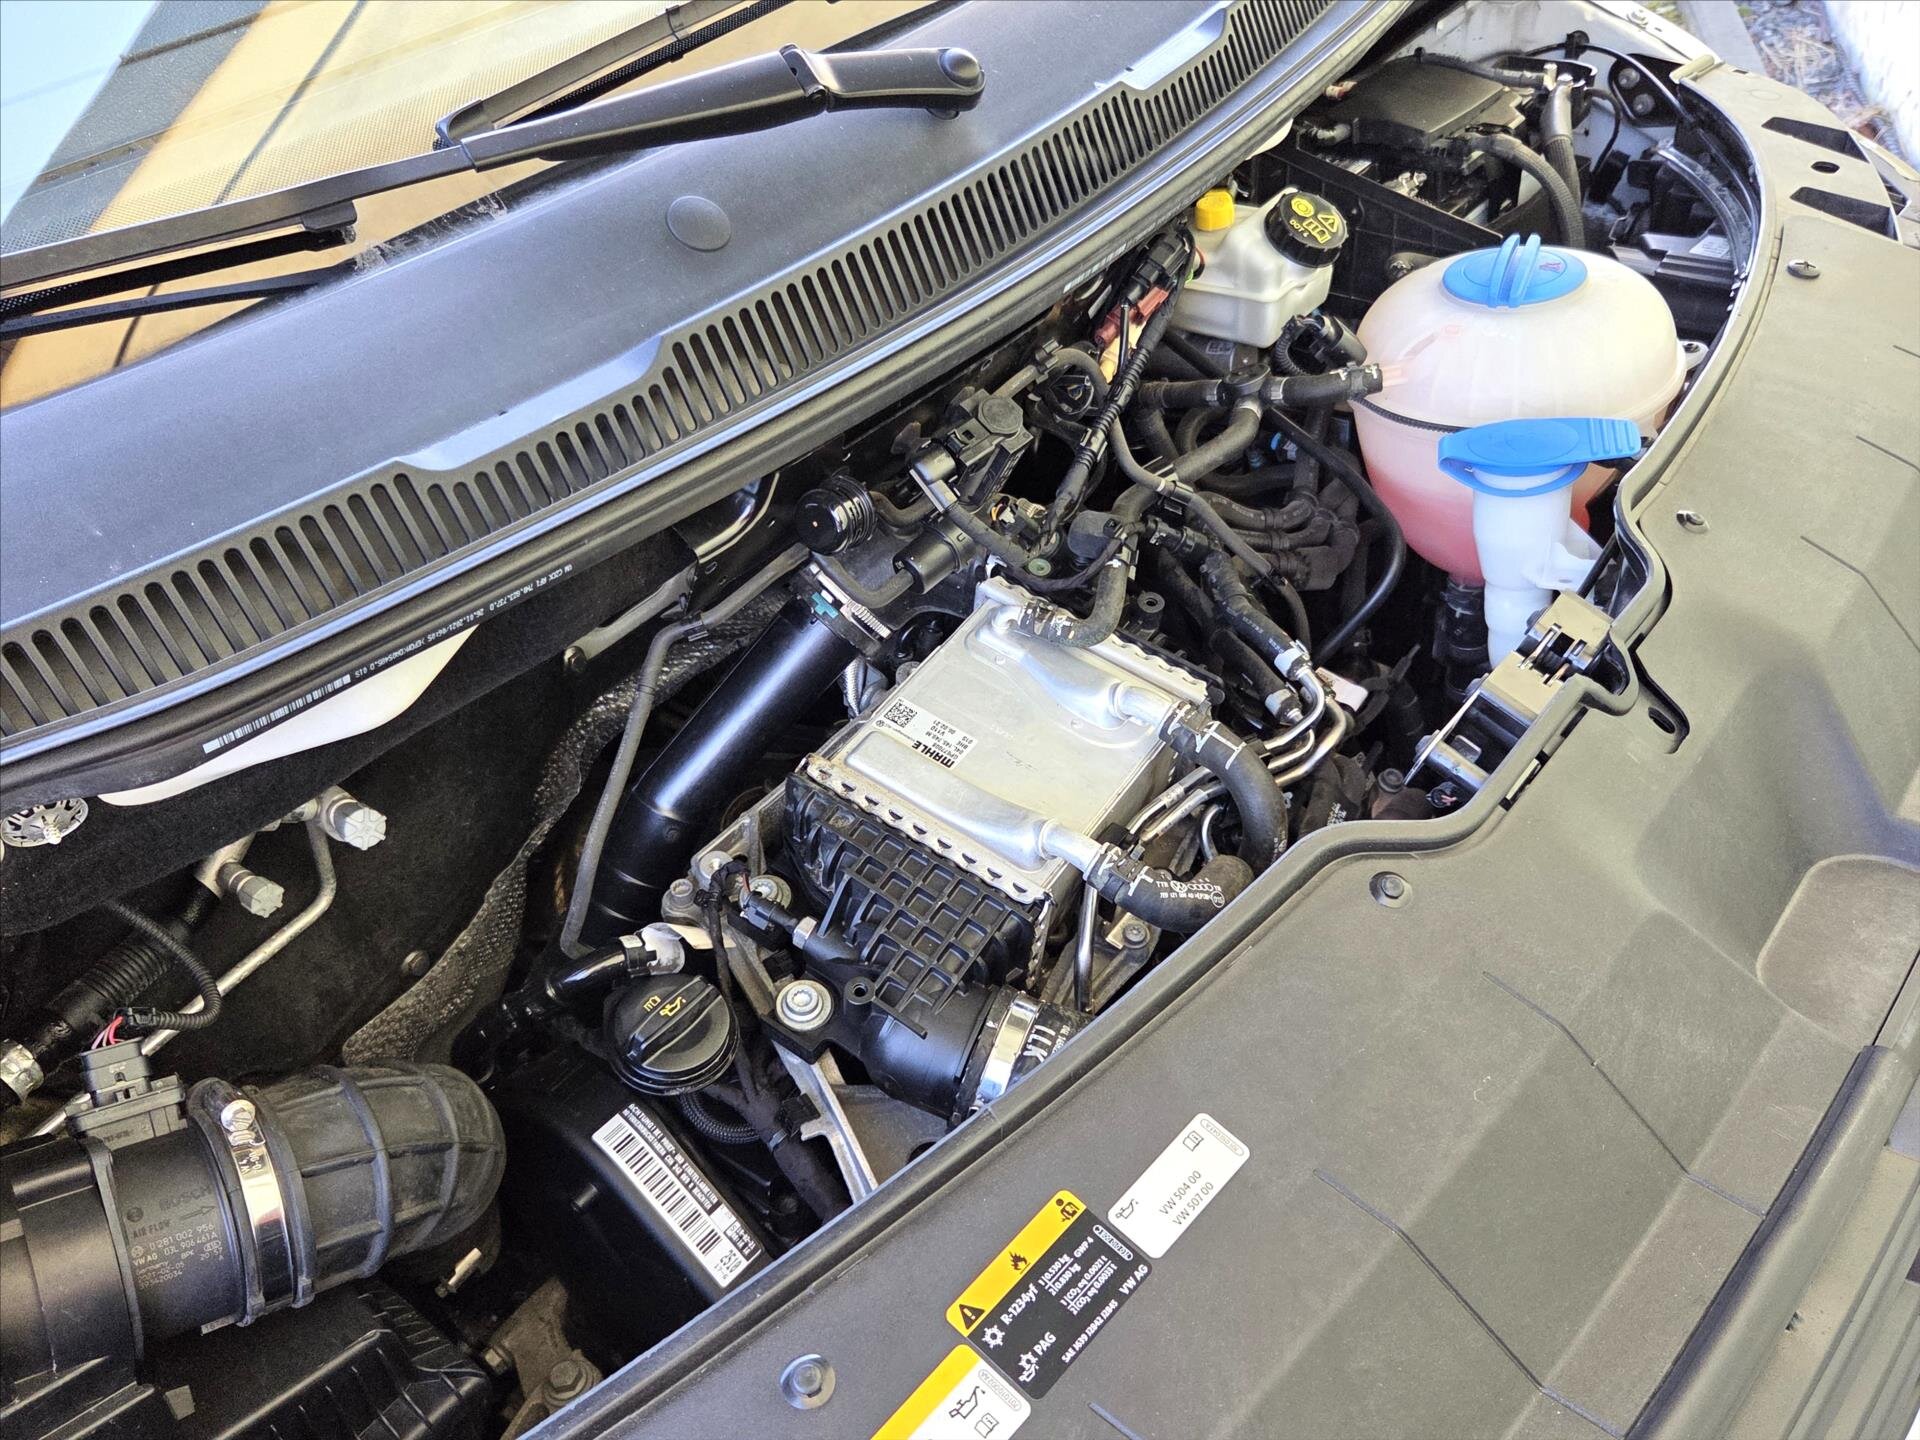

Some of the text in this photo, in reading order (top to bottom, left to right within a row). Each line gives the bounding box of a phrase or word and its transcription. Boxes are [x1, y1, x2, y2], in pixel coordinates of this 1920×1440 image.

[1290, 219, 1304, 232] DOT
[911, 738, 955, 769] MAHLE
[1023, 1024, 1055, 1062] LLK
[1158, 1168, 1202, 1216] VW 504 00
[1171, 1180, 1215, 1227] VW 507 00
[1057, 1252, 1070, 1264] kg
[1072, 1239, 1090, 1258] GWP
[1068, 1261, 1082, 1275] kg
[998, 1281, 1042, 1328] R-1234yf
[1060, 1347, 1076, 1363] SAE
[1118, 1275, 1138, 1296] VW
[1132, 1262, 1149, 1280] AG
[1032, 1329, 1058, 1357] PAG
